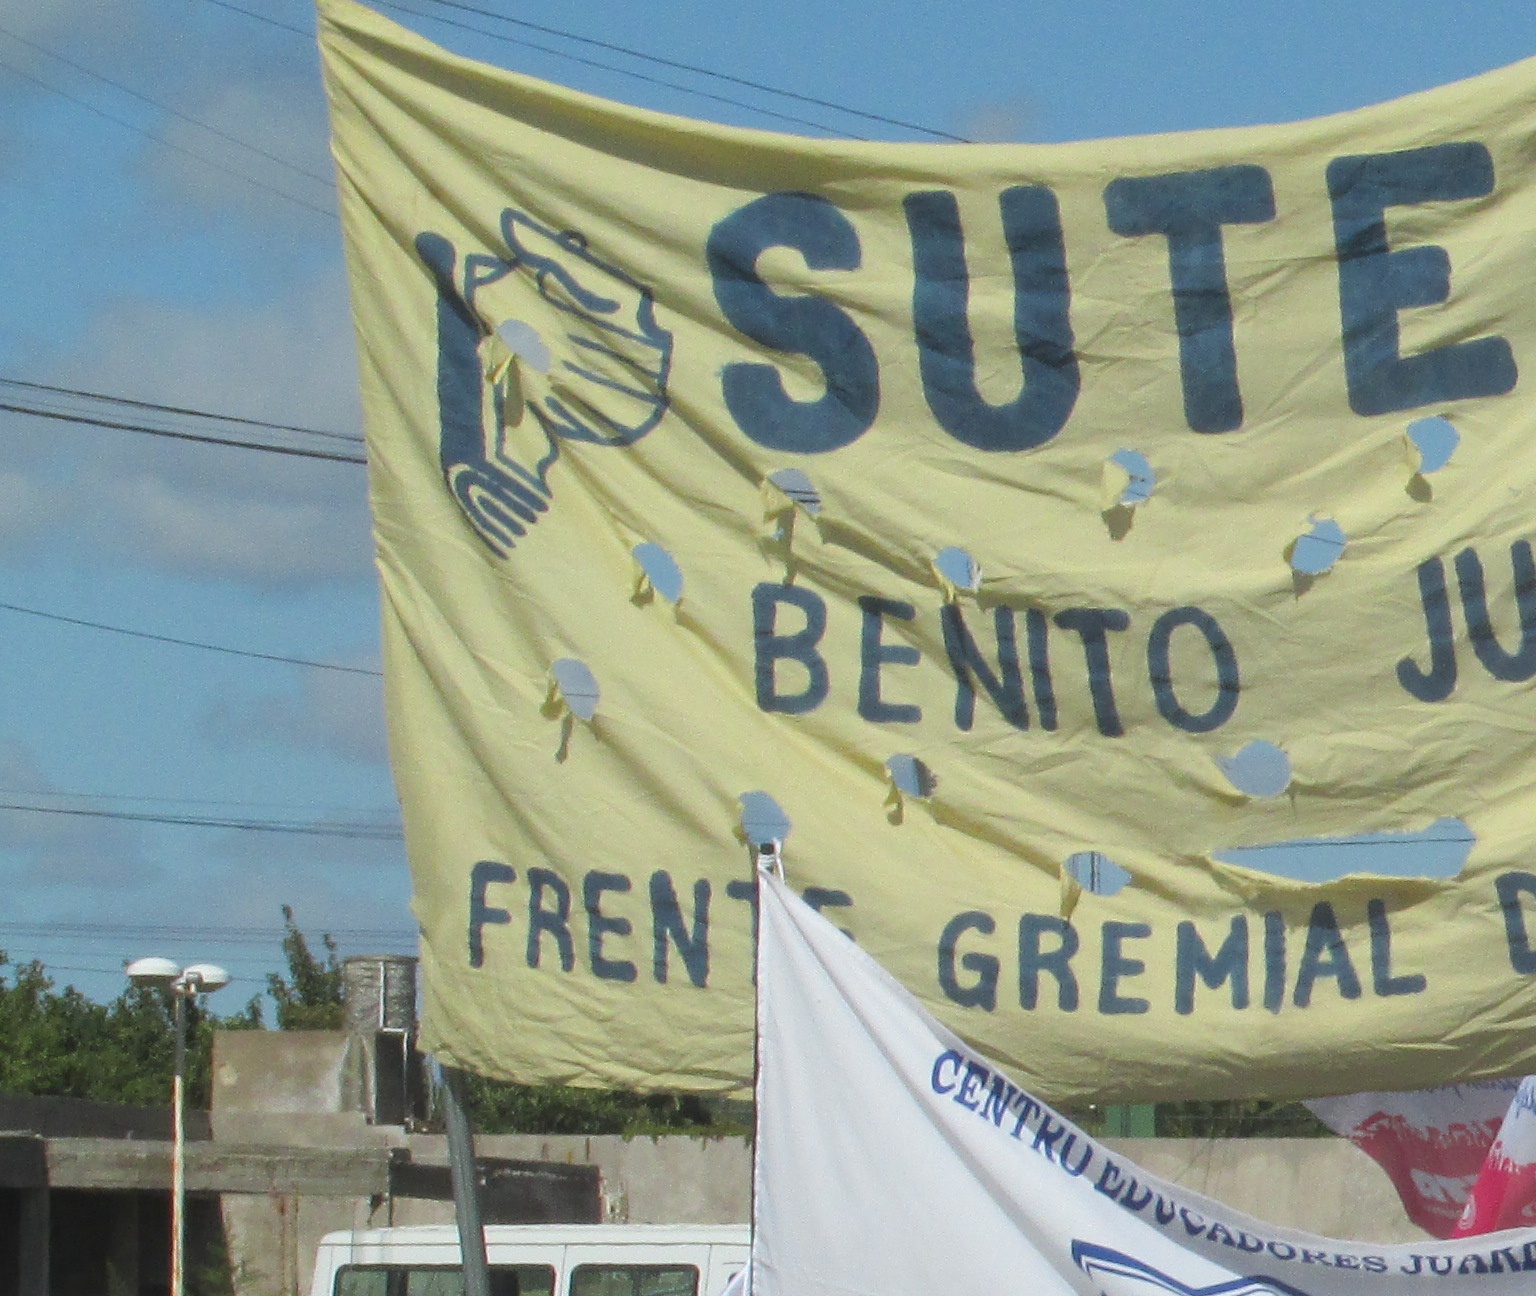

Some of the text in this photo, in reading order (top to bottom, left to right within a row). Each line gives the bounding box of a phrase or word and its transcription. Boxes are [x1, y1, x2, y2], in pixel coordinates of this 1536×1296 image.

[751, 582, 1240, 739] BENITO
[469, 861, 855, 988] FREN
[937, 899, 1427, 1016] GREMIAL
[1094, 1157, 1388, 1272] EDUCADORES
